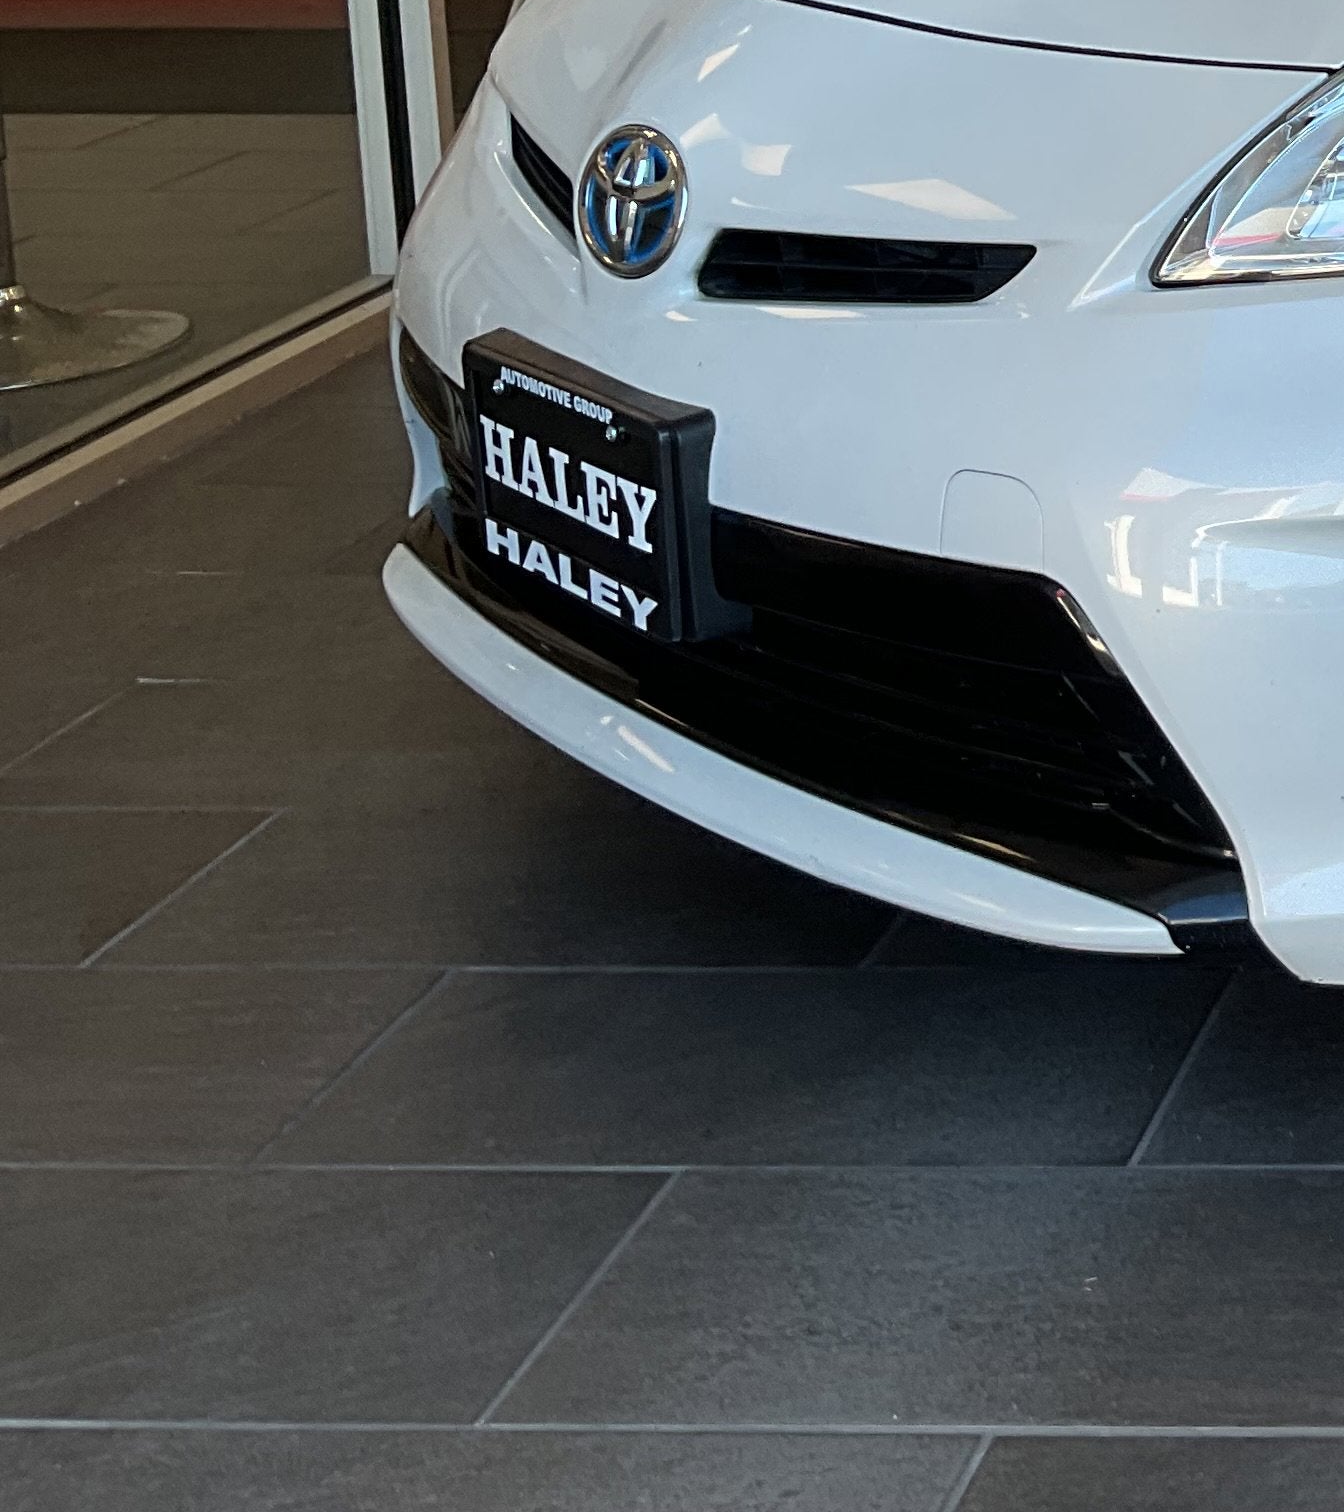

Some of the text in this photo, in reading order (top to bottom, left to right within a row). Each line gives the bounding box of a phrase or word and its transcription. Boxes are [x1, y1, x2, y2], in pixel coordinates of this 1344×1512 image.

[501, 365, 613, 425] AUTOMOTIVE GROUP
[480, 413, 657, 554] HALEY
[484, 517, 658, 631] HALEY
